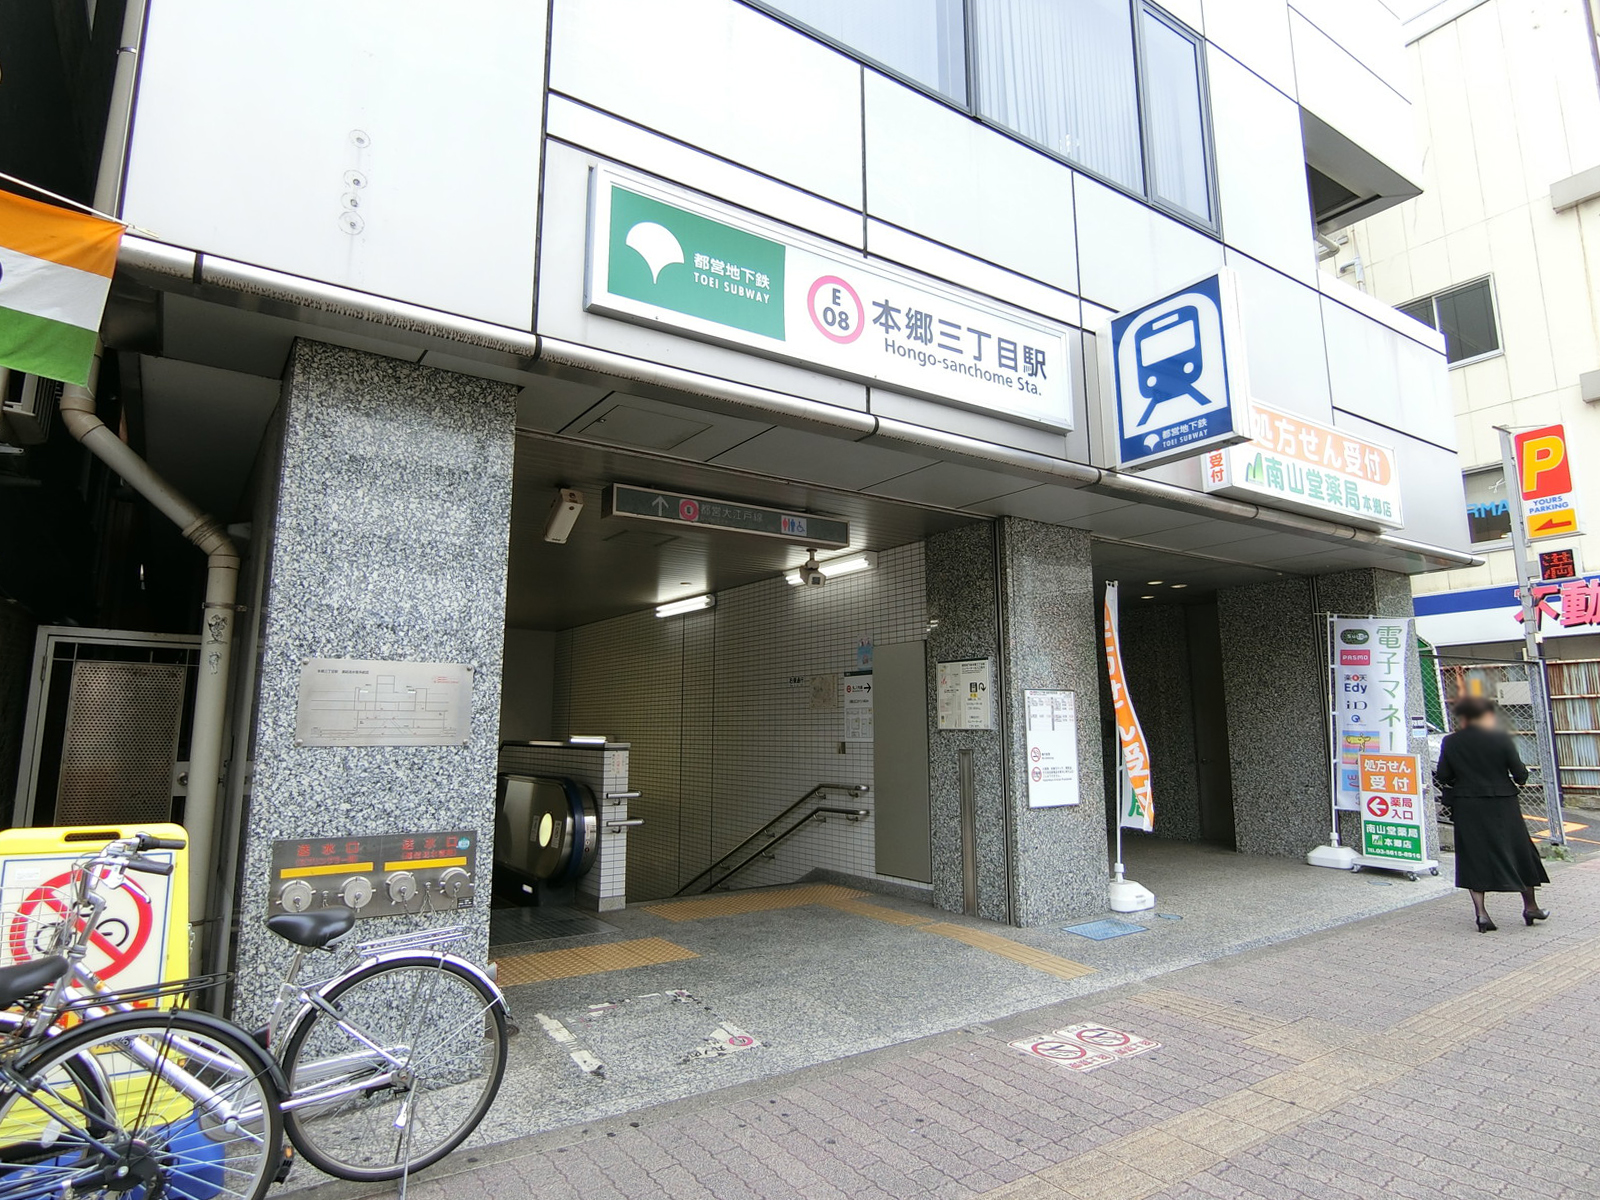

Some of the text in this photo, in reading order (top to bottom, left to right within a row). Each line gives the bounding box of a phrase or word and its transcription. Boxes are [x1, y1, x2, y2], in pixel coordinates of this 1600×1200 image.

[693, 252, 770, 290] 都営地下鉄
[693, 271, 770, 304] TOEI SUBWAY
[832, 287, 841, 307] E
[822, 306, 850, 331] 08
[872, 298, 1048, 380] 本郷三丁目駅
[884, 337, 1042, 396] Hongo-sanchome Sta.
[1162, 417, 1208, 440] 都営地下鉄
[1162, 429, 1208, 448] TOEI SUBWAY
[1249, 412, 1381, 485] 処方せん受付
[1208, 448, 1224, 484] 受付
[1522, 435, 1565, 494] P
[1264, 456, 1360, 511] 南山堂薬局
[1529, 501, 1569, 514] PARKING
[1532, 496, 1563, 506] YOURS
[1542, 551, 1575, 580] 満
[1344, 683, 1367, 694] Edy
[1376, 625, 1402, 752] 電子マネー
[1346, 701, 1367, 711] iD
[1364, 759, 1411, 774] 処方せん
[1370, 775, 1409, 792] 受付
[1390, 797, 1413, 808] 薬局
[1391, 809, 1413, 821] 入口
[1365, 824, 1419, 838] 南山堂薬局
[1383, 838, 1412, 849] 本郷店
